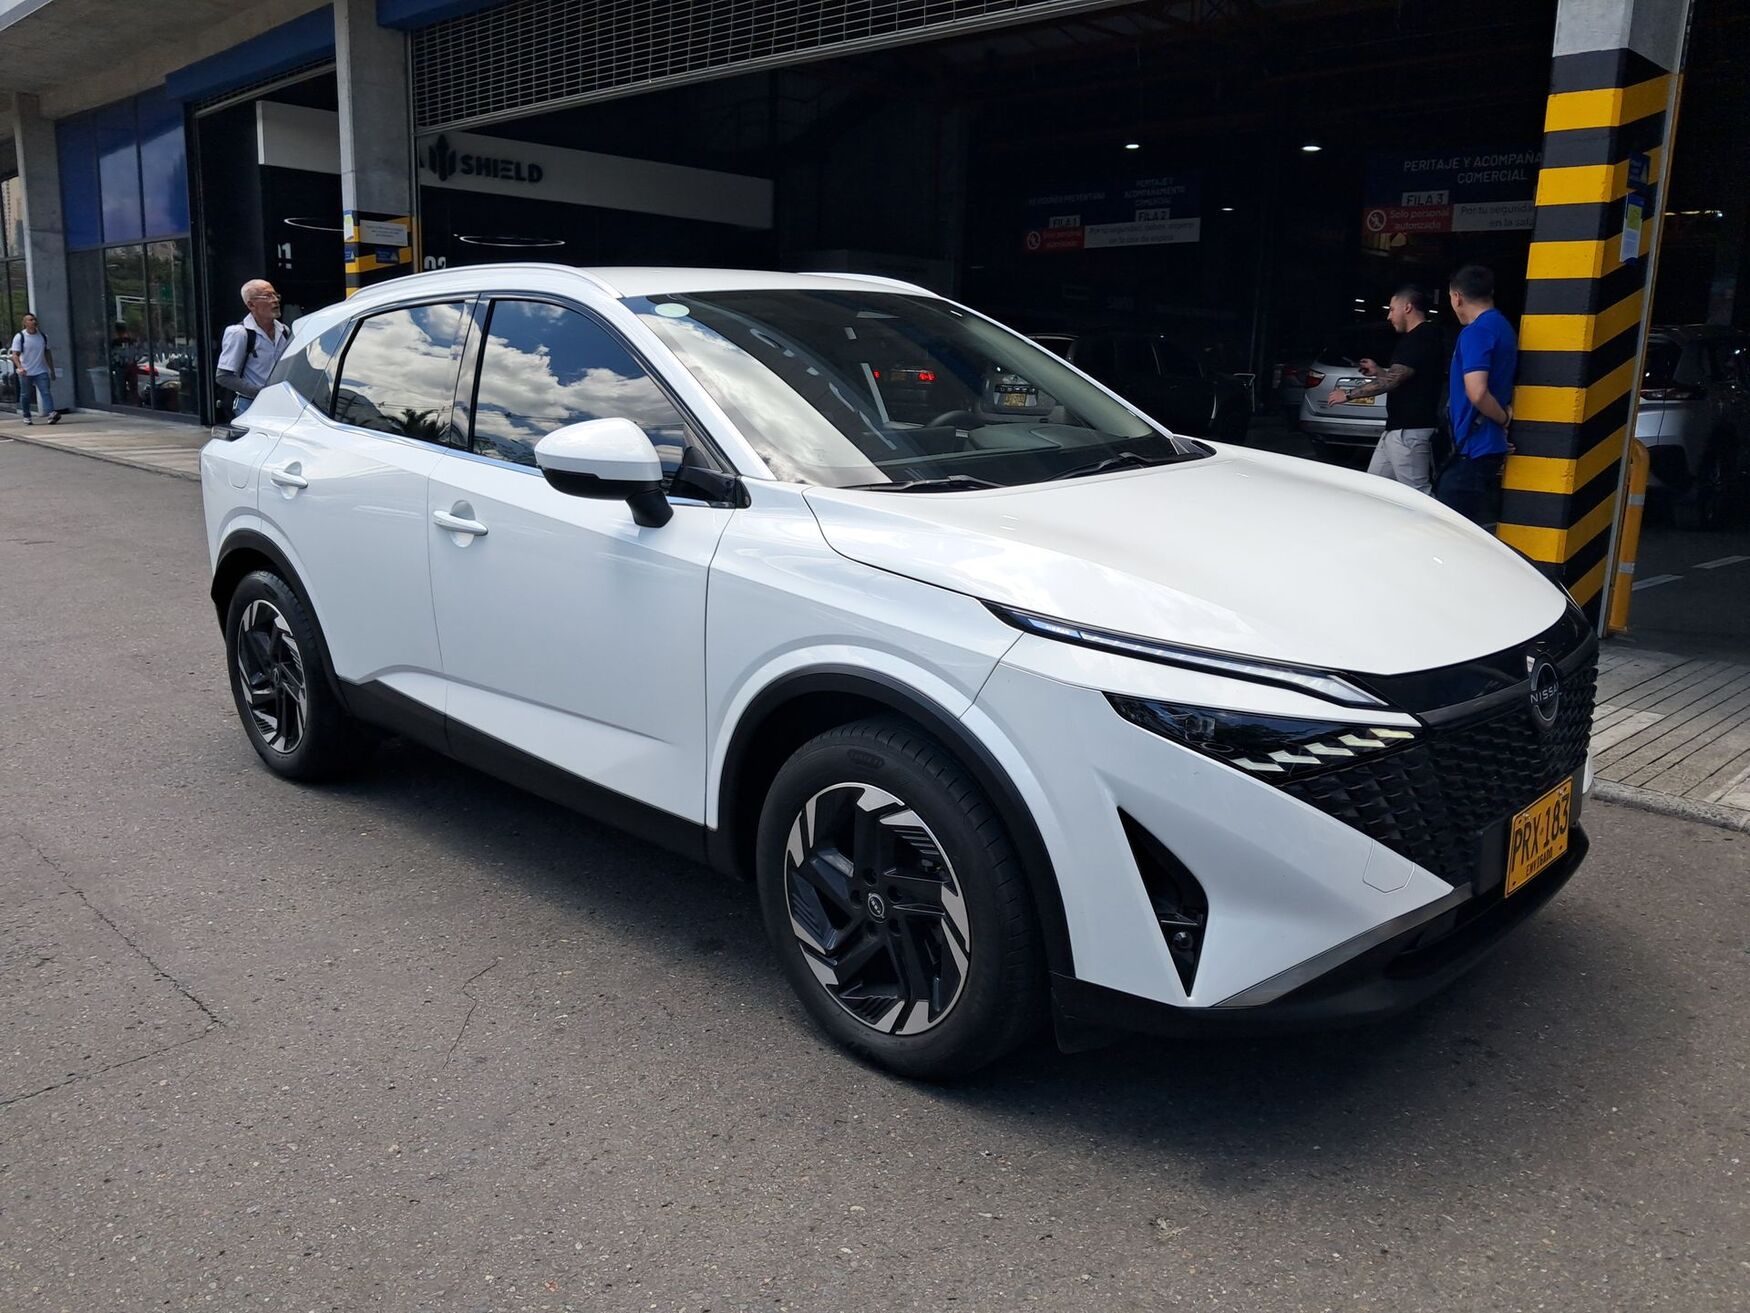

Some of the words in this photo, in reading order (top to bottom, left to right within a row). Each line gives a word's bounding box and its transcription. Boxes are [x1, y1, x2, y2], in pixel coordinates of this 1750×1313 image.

[460, 153, 544, 183] SHIELD
[1403, 157, 1460, 172] PERITAJE
[1463, 156, 1472, 168] Y
[1457, 168, 1528, 184] COMERCIAL
[1407, 194, 1433, 206] FILA
